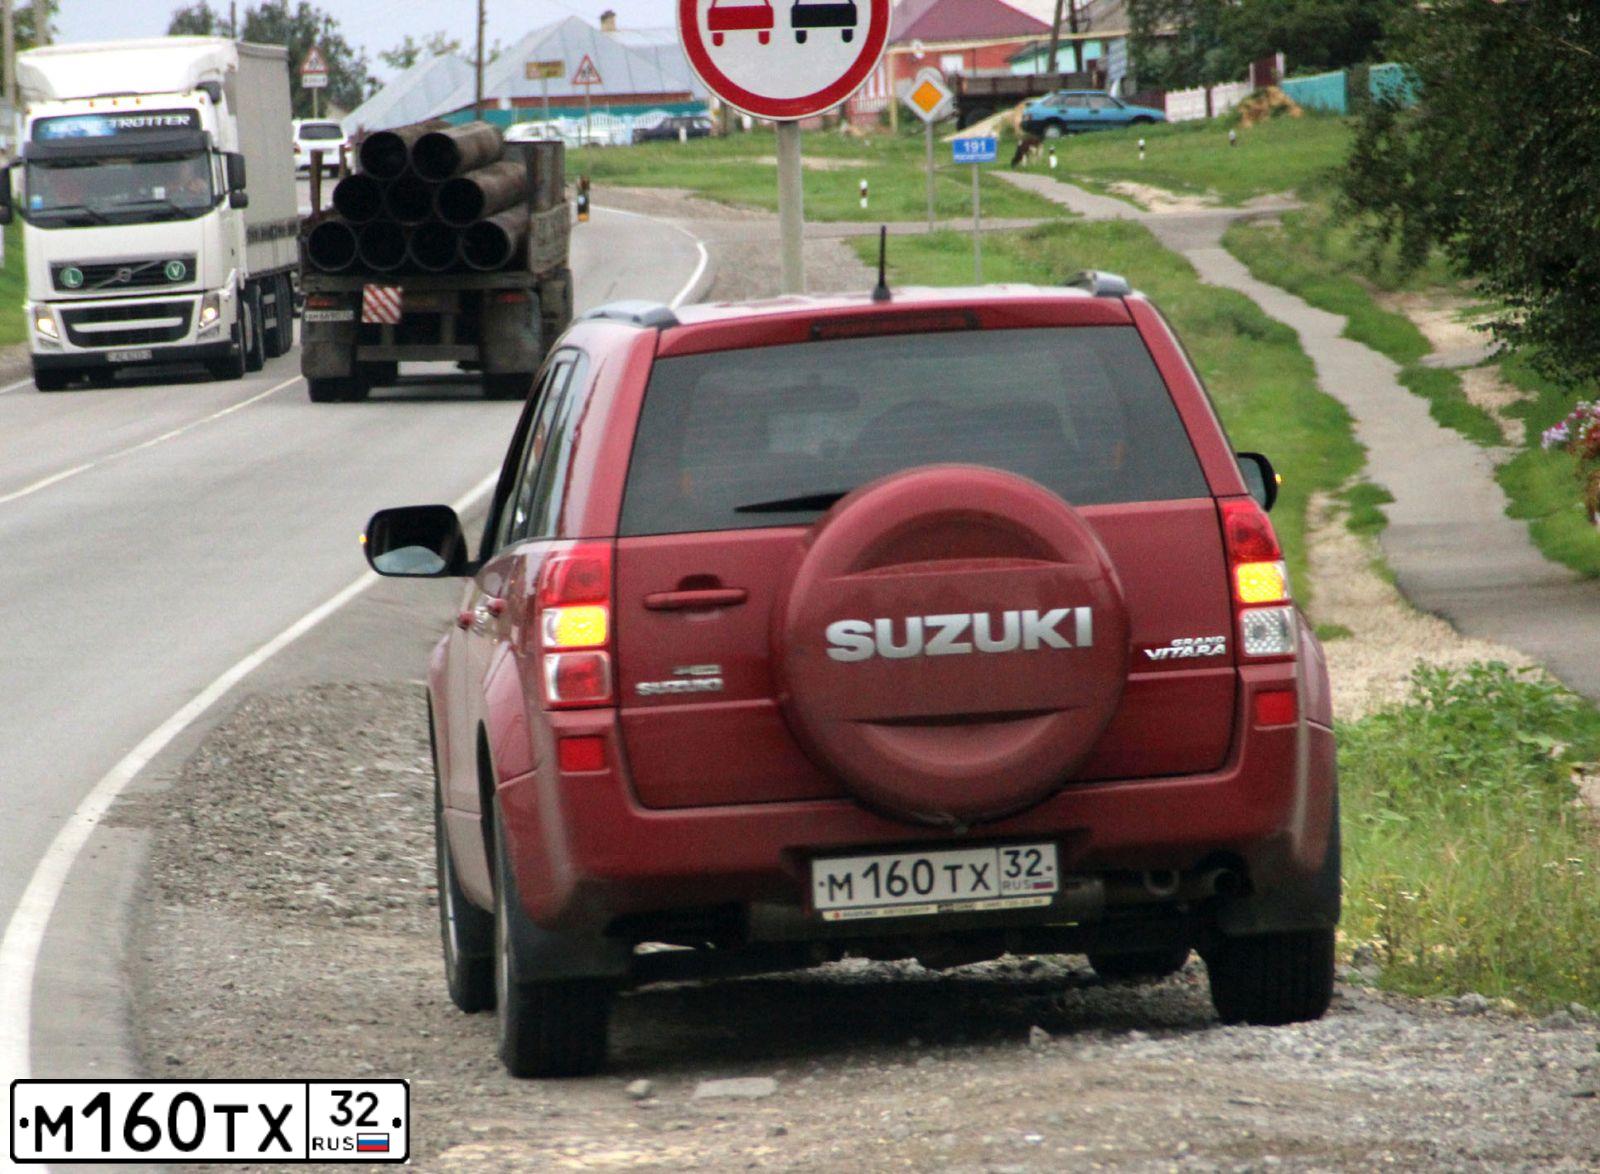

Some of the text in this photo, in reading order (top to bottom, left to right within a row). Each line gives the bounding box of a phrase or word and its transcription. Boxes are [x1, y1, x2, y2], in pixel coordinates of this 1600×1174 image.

[962, 141, 986, 153] 191
[825, 606, 1093, 662] SUZUKI
[1171, 636, 1226, 647] GRAND
[1143, 644, 1226, 660] VITARA
[1004, 848, 1043, 878] 32
[1002, 880, 1032, 890] RUS
